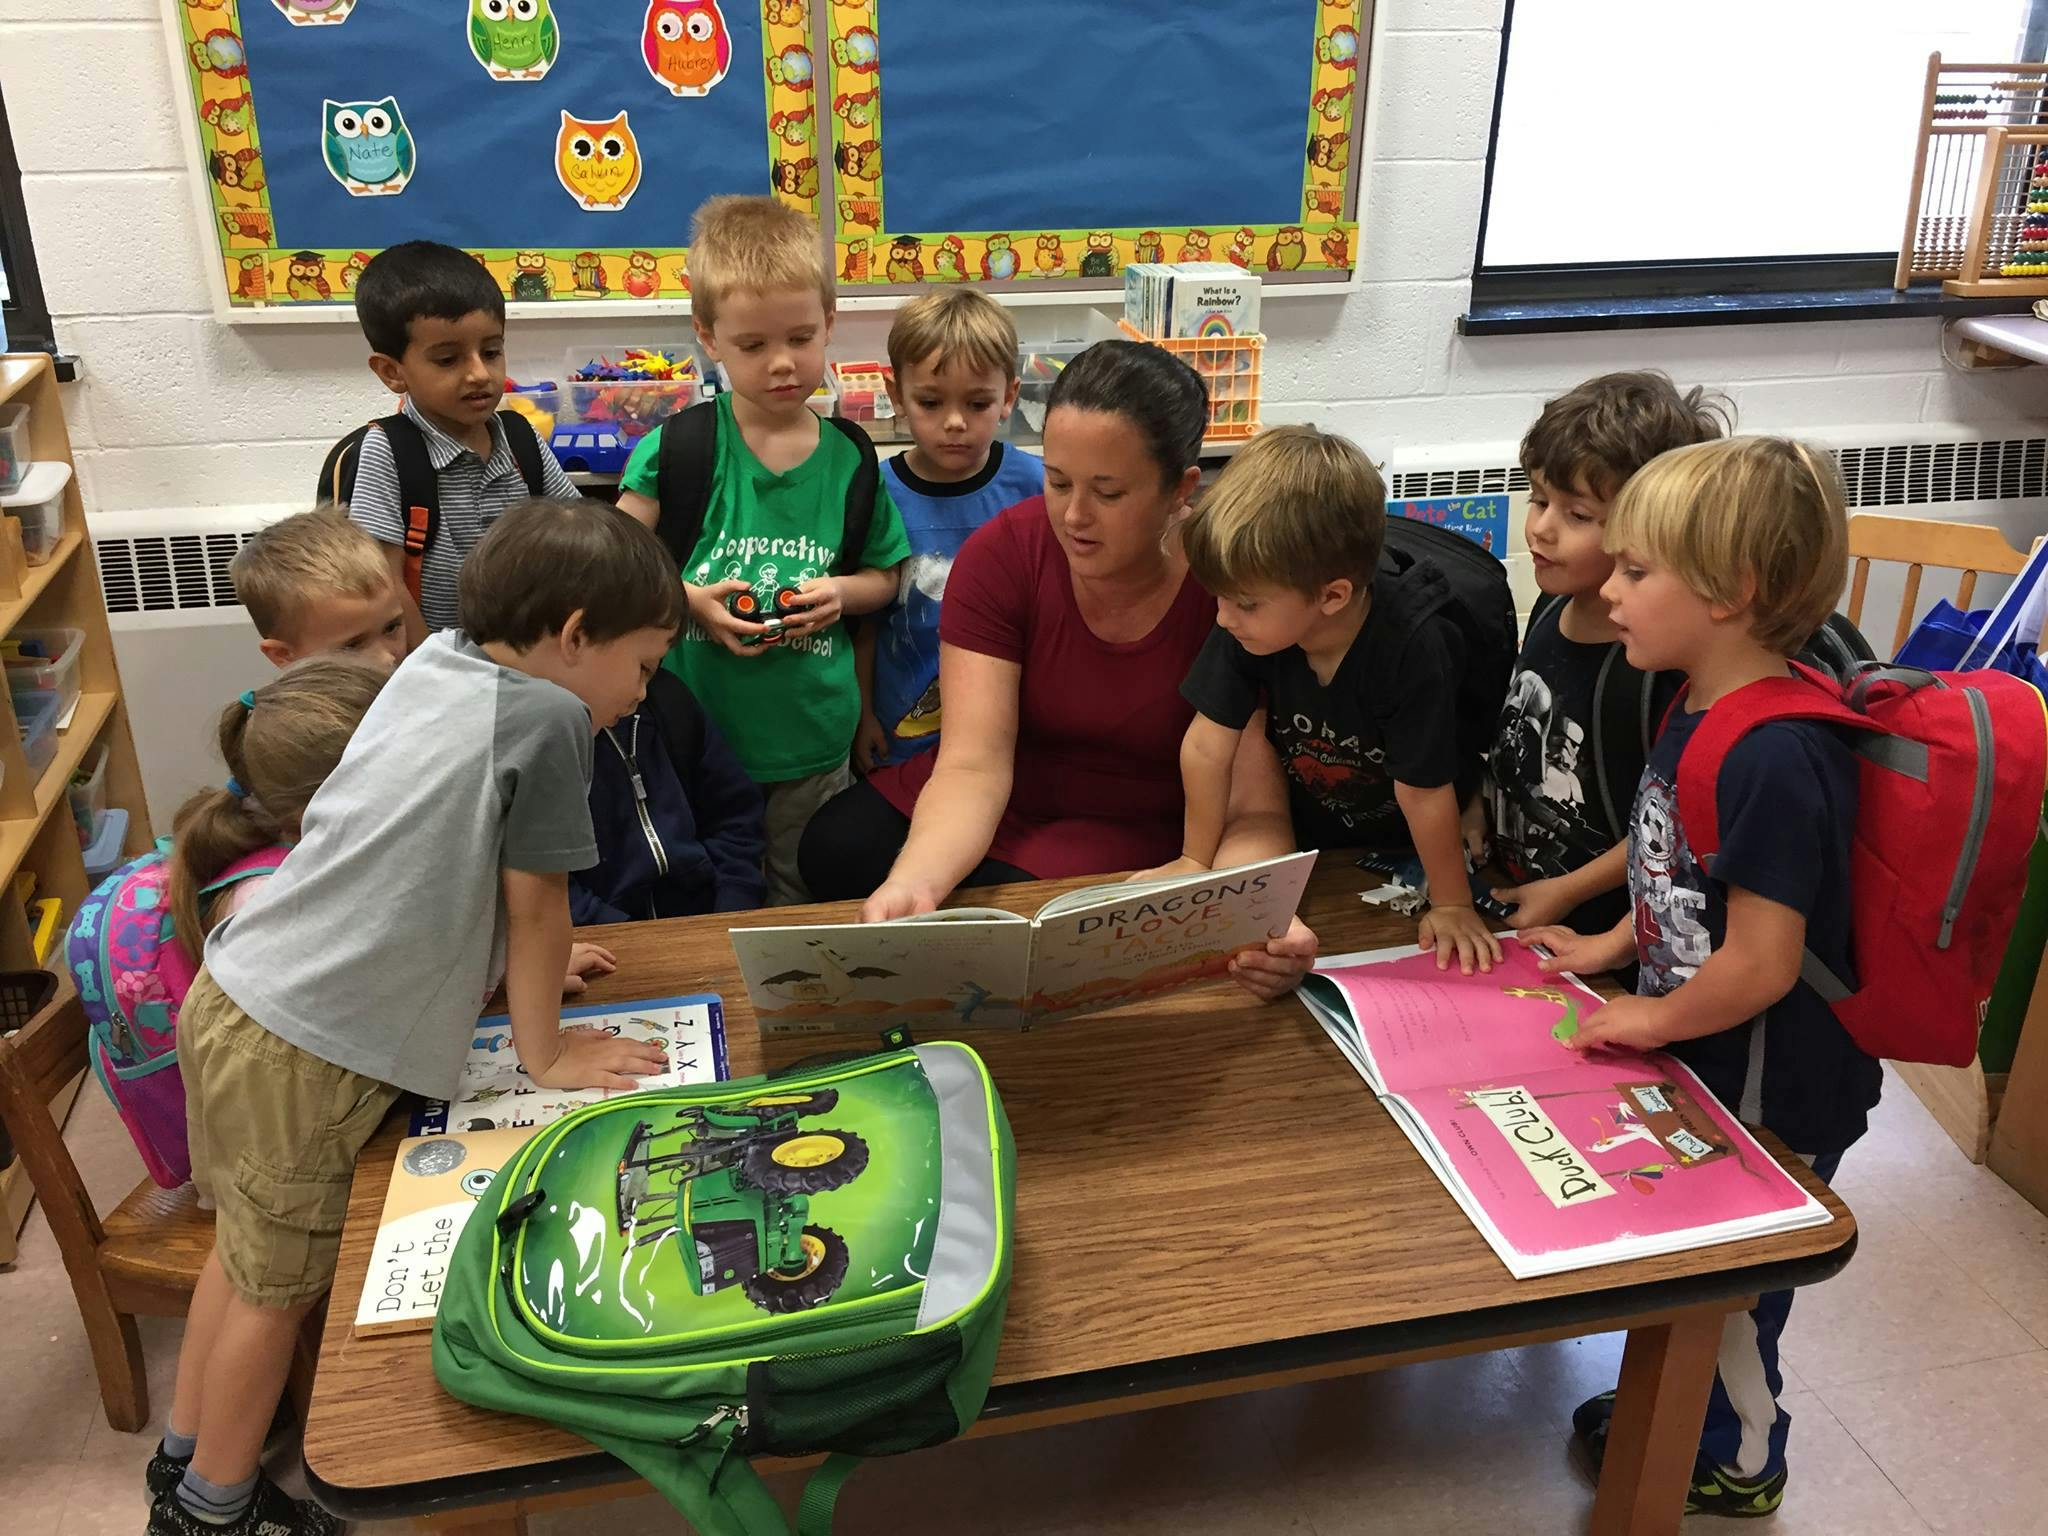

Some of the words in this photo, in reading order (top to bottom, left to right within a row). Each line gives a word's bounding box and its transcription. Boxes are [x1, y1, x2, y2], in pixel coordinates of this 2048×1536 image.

[493, 33, 537, 51] Henry
[349, 142, 394, 161] Nate
[1197, 295, 1241, 307] Rainbow?
[1203, 287, 1222, 295] What
[1405, 502, 1447, 524] Pete
[1462, 500, 1497, 520] Cat
[711, 530, 836, 568] Cooperative
[1078, 873, 1272, 935] DRAGONS
[1115, 902, 1223, 940] LOVE
[1101, 919, 1236, 960] TACOS
[675, 1041, 695, 1050] Y
[676, 1058, 698, 1070] X
[512, 1119, 535, 1128] E
[1673, 1133, 1705, 1154] Cool!
[423, 1218, 453, 1256] the
[376, 1241, 415, 1313] Don't
[412, 1266, 445, 1310] Let
